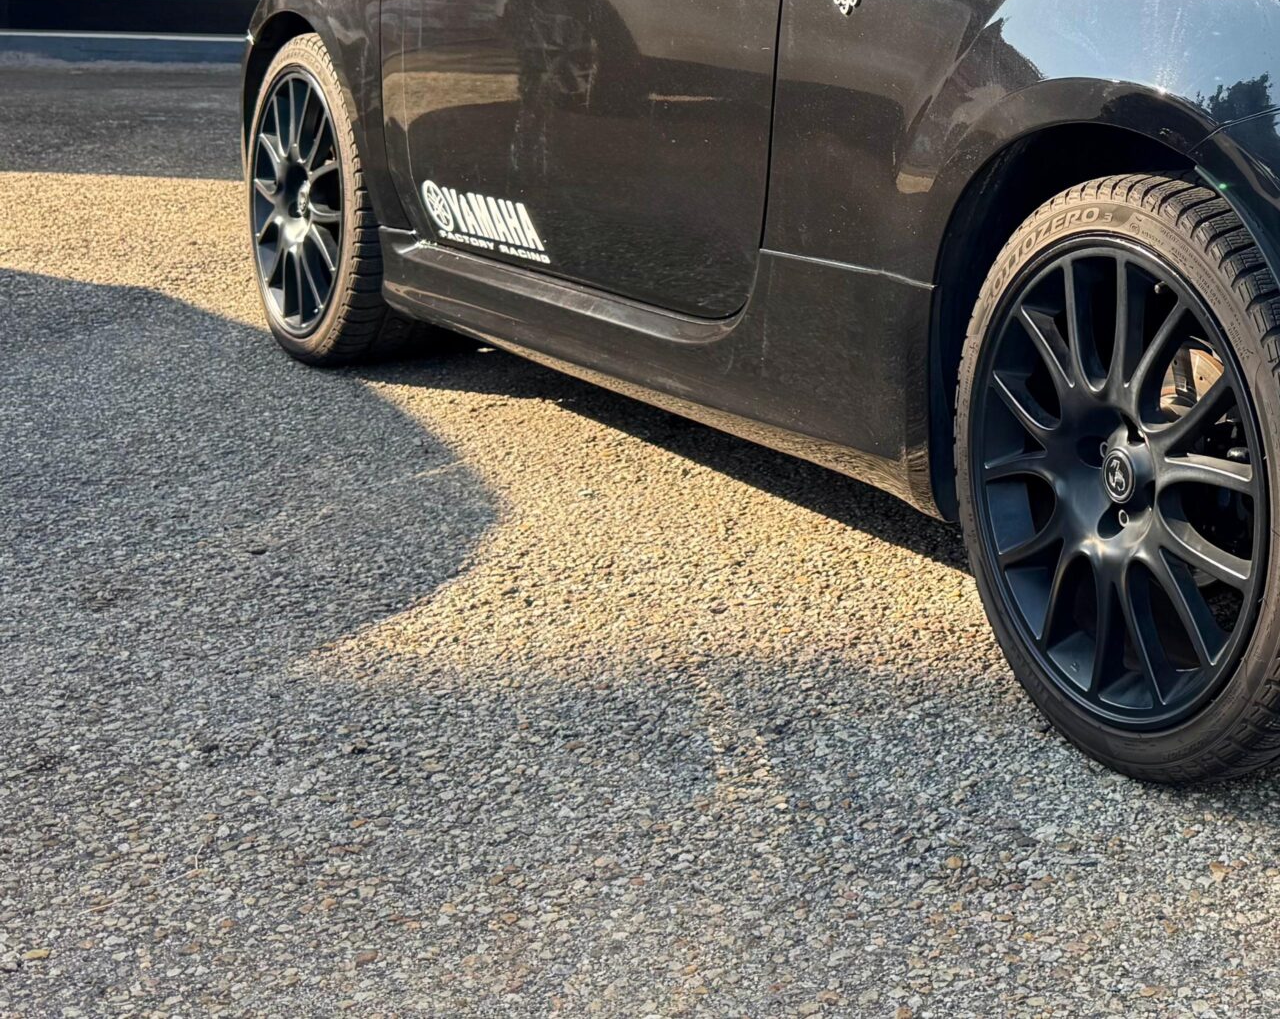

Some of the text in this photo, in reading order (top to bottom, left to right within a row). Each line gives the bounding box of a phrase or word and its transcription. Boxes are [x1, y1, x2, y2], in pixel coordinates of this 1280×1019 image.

[441, 186, 546, 251] YAMAHA
[1102, 212, 1113, 223] 3
[438, 229, 551, 264] FACTORY RACING
